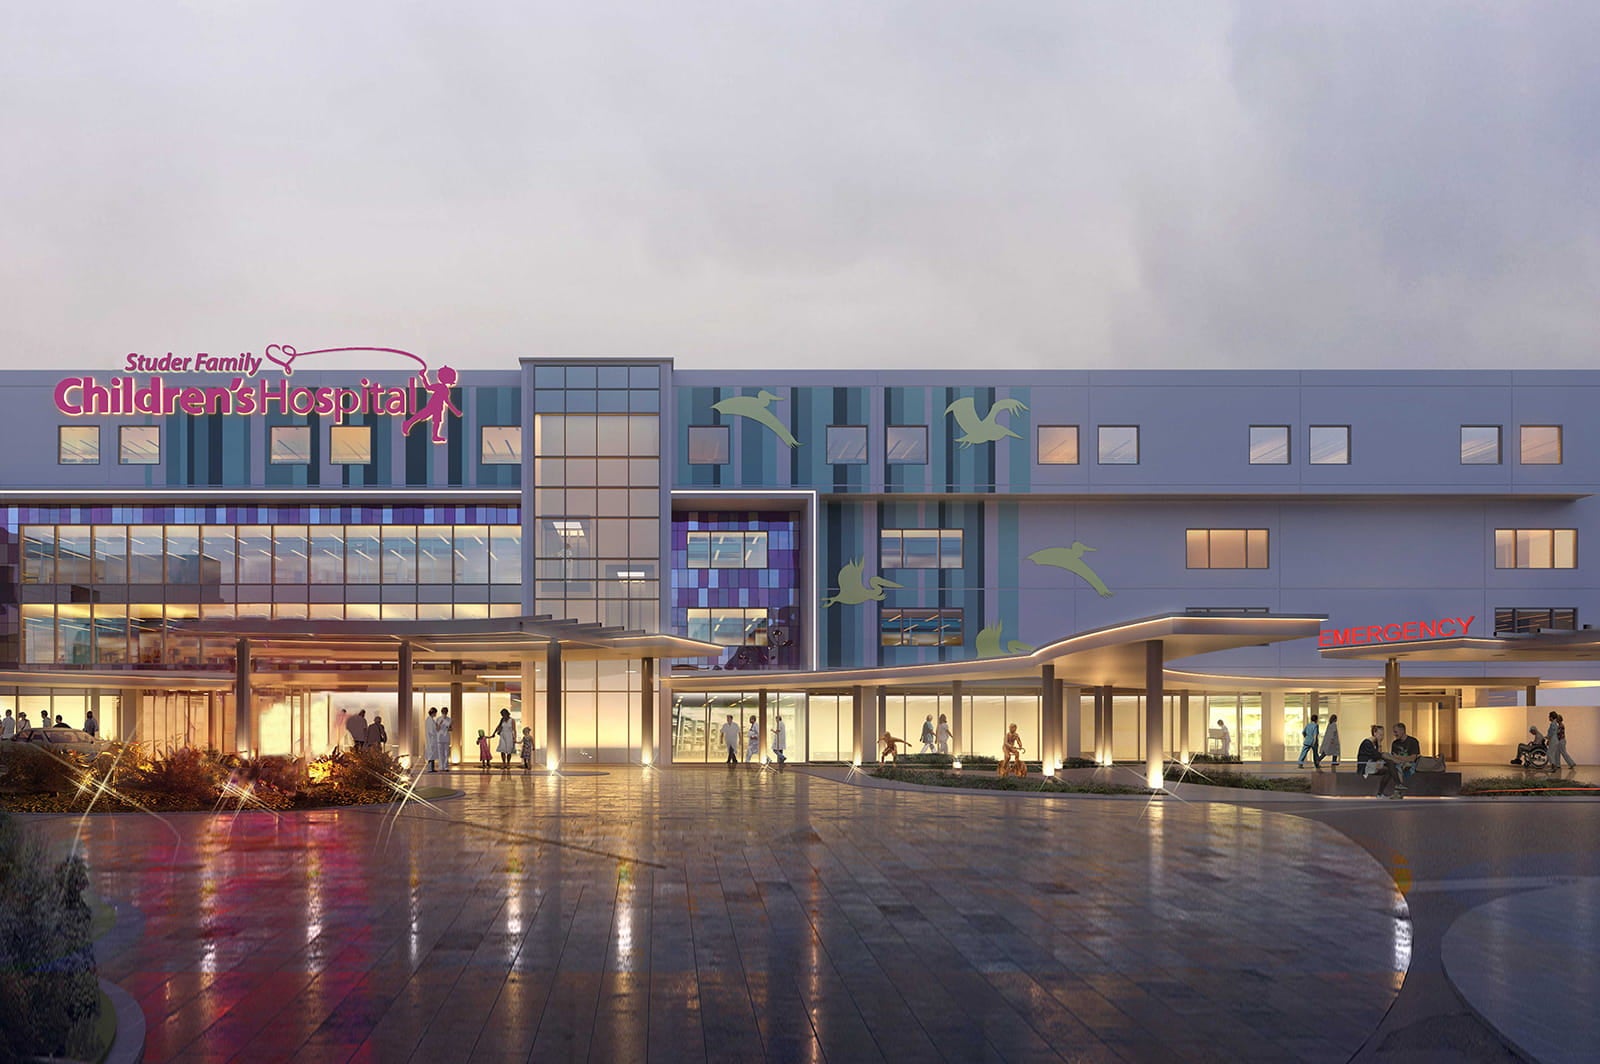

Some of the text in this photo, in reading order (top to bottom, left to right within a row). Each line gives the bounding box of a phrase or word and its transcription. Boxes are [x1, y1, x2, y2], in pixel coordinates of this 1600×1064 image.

[125, 353, 263, 376] Studer Family
[53, 376, 417, 424] Children's Hospital
[1318, 615, 1475, 647] EMERGENCY
